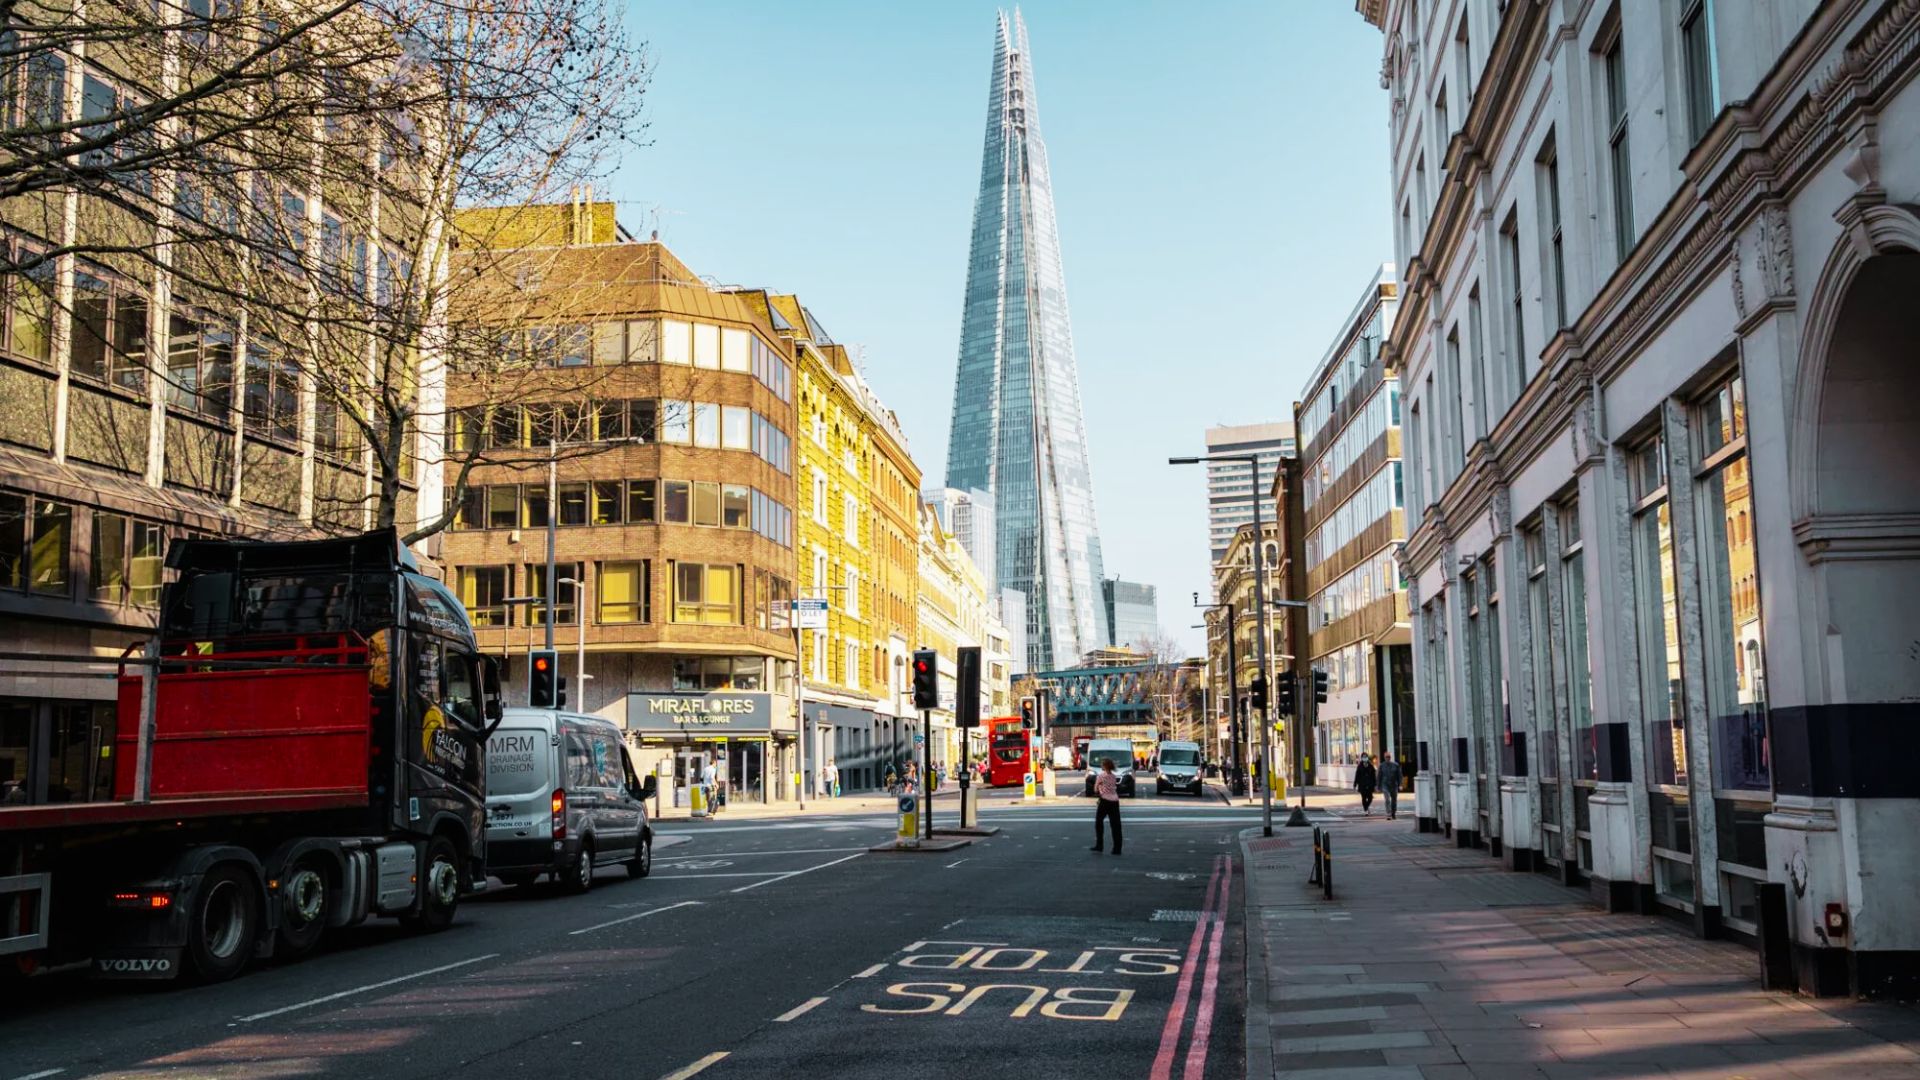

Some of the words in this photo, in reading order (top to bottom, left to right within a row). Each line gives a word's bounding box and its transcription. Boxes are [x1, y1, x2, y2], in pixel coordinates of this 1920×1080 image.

[648, 698, 755, 714] MIRAFLORES
[673, 715, 691, 724] BAR
[691, 715, 699, 724] &
[699, 715, 731, 724] LOUNGE
[435, 729, 468, 761] FALCON
[490, 735, 535, 753] MRM
[489, 753, 535, 765] DRAINAGE
[489, 762, 535, 775] DIVISION
[100, 959, 171, 971] VOLVO
[898, 946, 1182, 976] STOP
[860, 982, 1136, 1021] BUS
